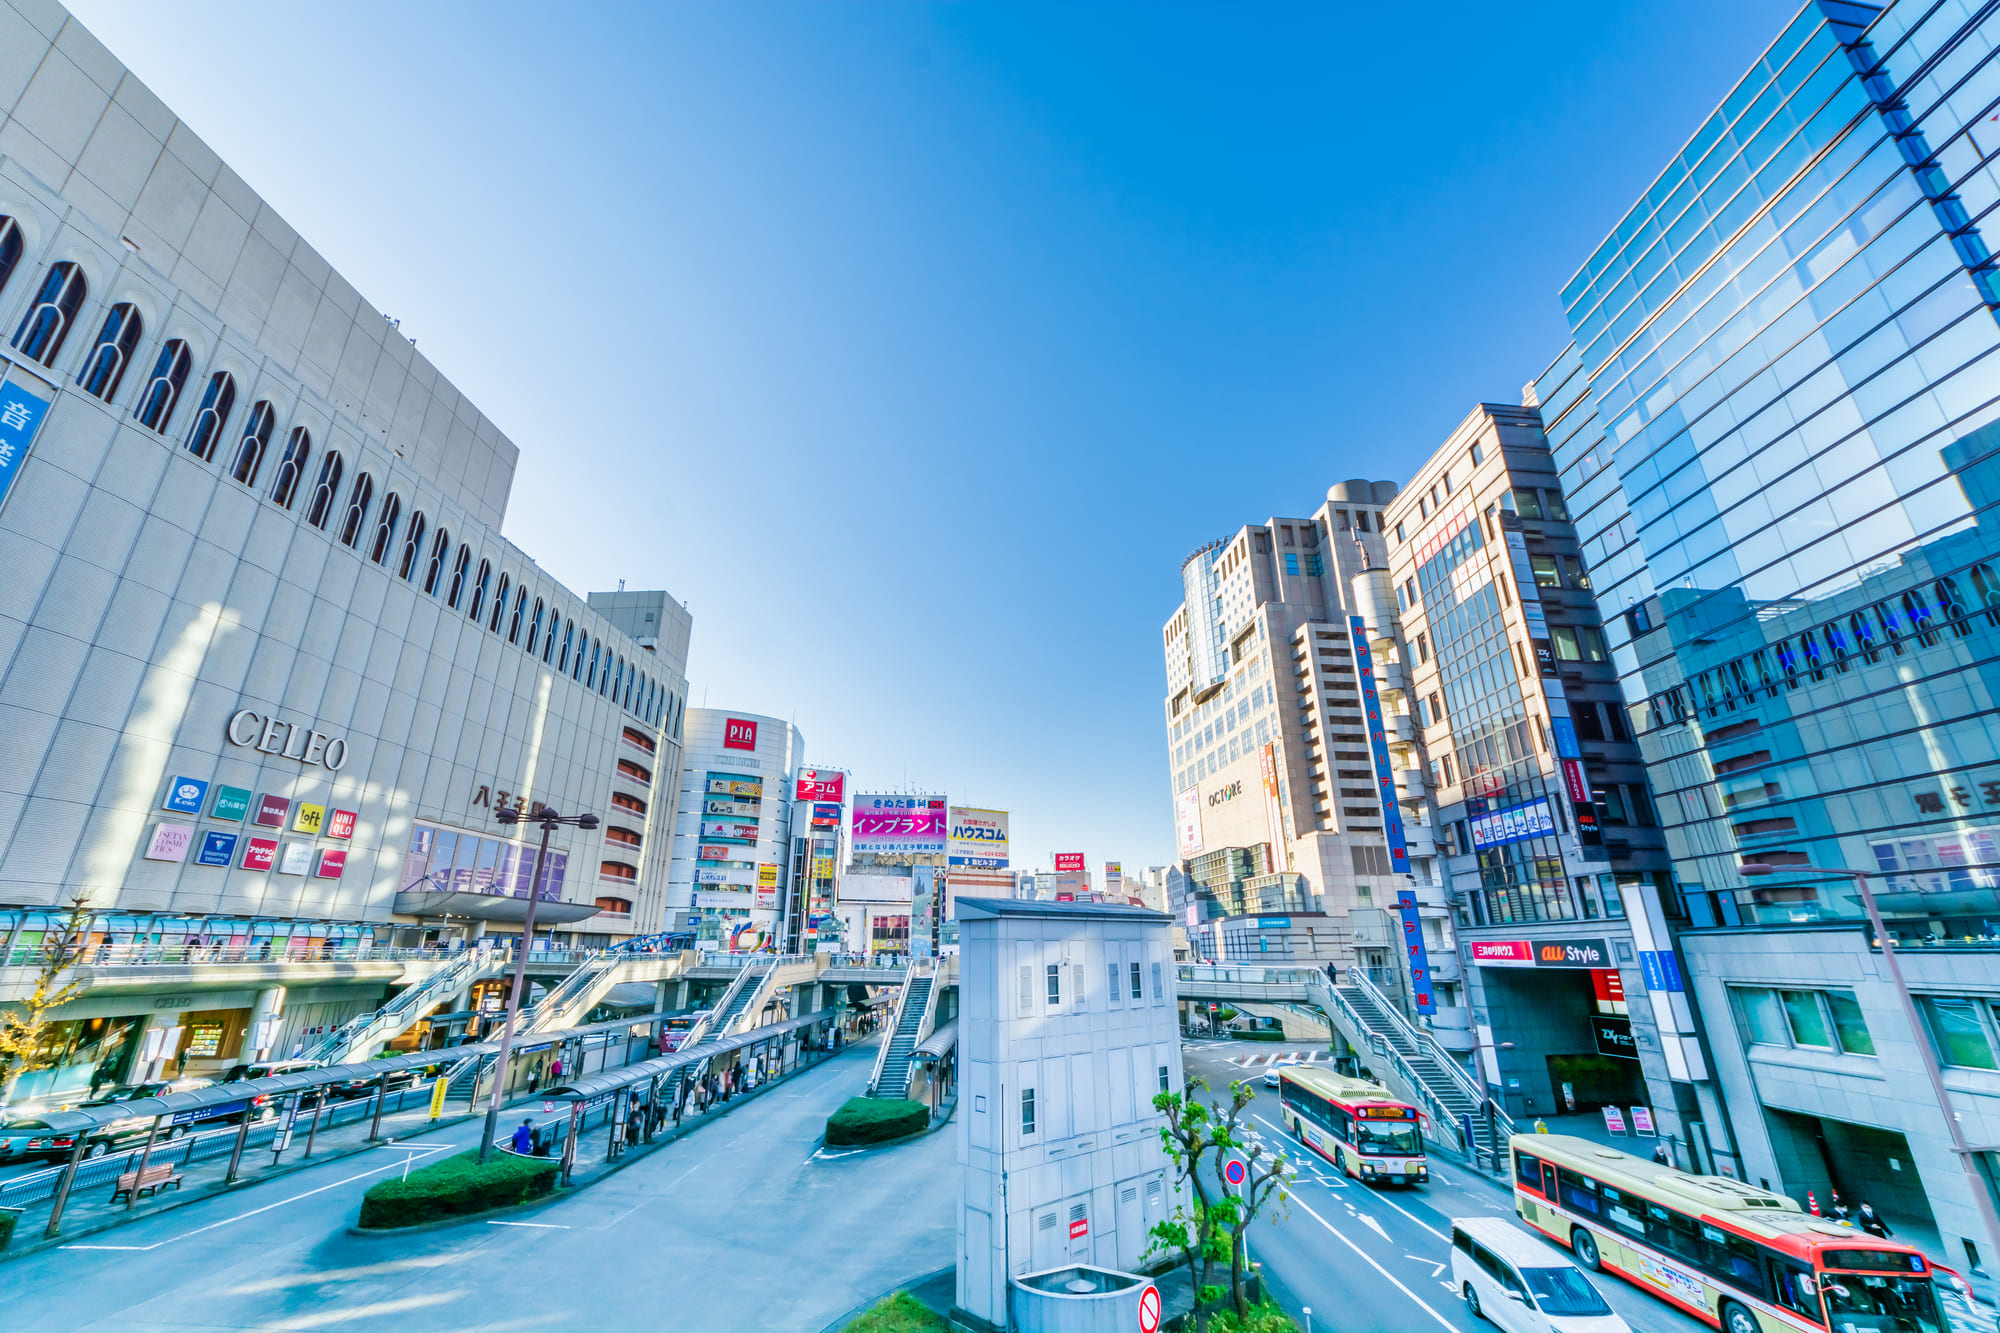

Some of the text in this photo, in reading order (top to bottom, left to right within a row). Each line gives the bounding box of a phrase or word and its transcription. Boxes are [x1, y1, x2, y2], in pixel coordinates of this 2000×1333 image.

[229, 709, 349, 771] CELEO
[730, 725, 752, 740] PIA
[804, 781, 835, 793] アコム
[1209, 780, 1242, 807] OCTORE
[174, 796, 196, 807] Keio
[336, 813, 353, 825] UNI
[853, 817, 946, 833] インプラント
[333, 825, 351, 835] QLO
[953, 826, 1006, 841] ハウスコム
[1401, 898, 1430, 1006] カラオケ館
[1478, 946, 1515, 956] 三井のリハウス
[1541, 945, 1600, 963] au Style
